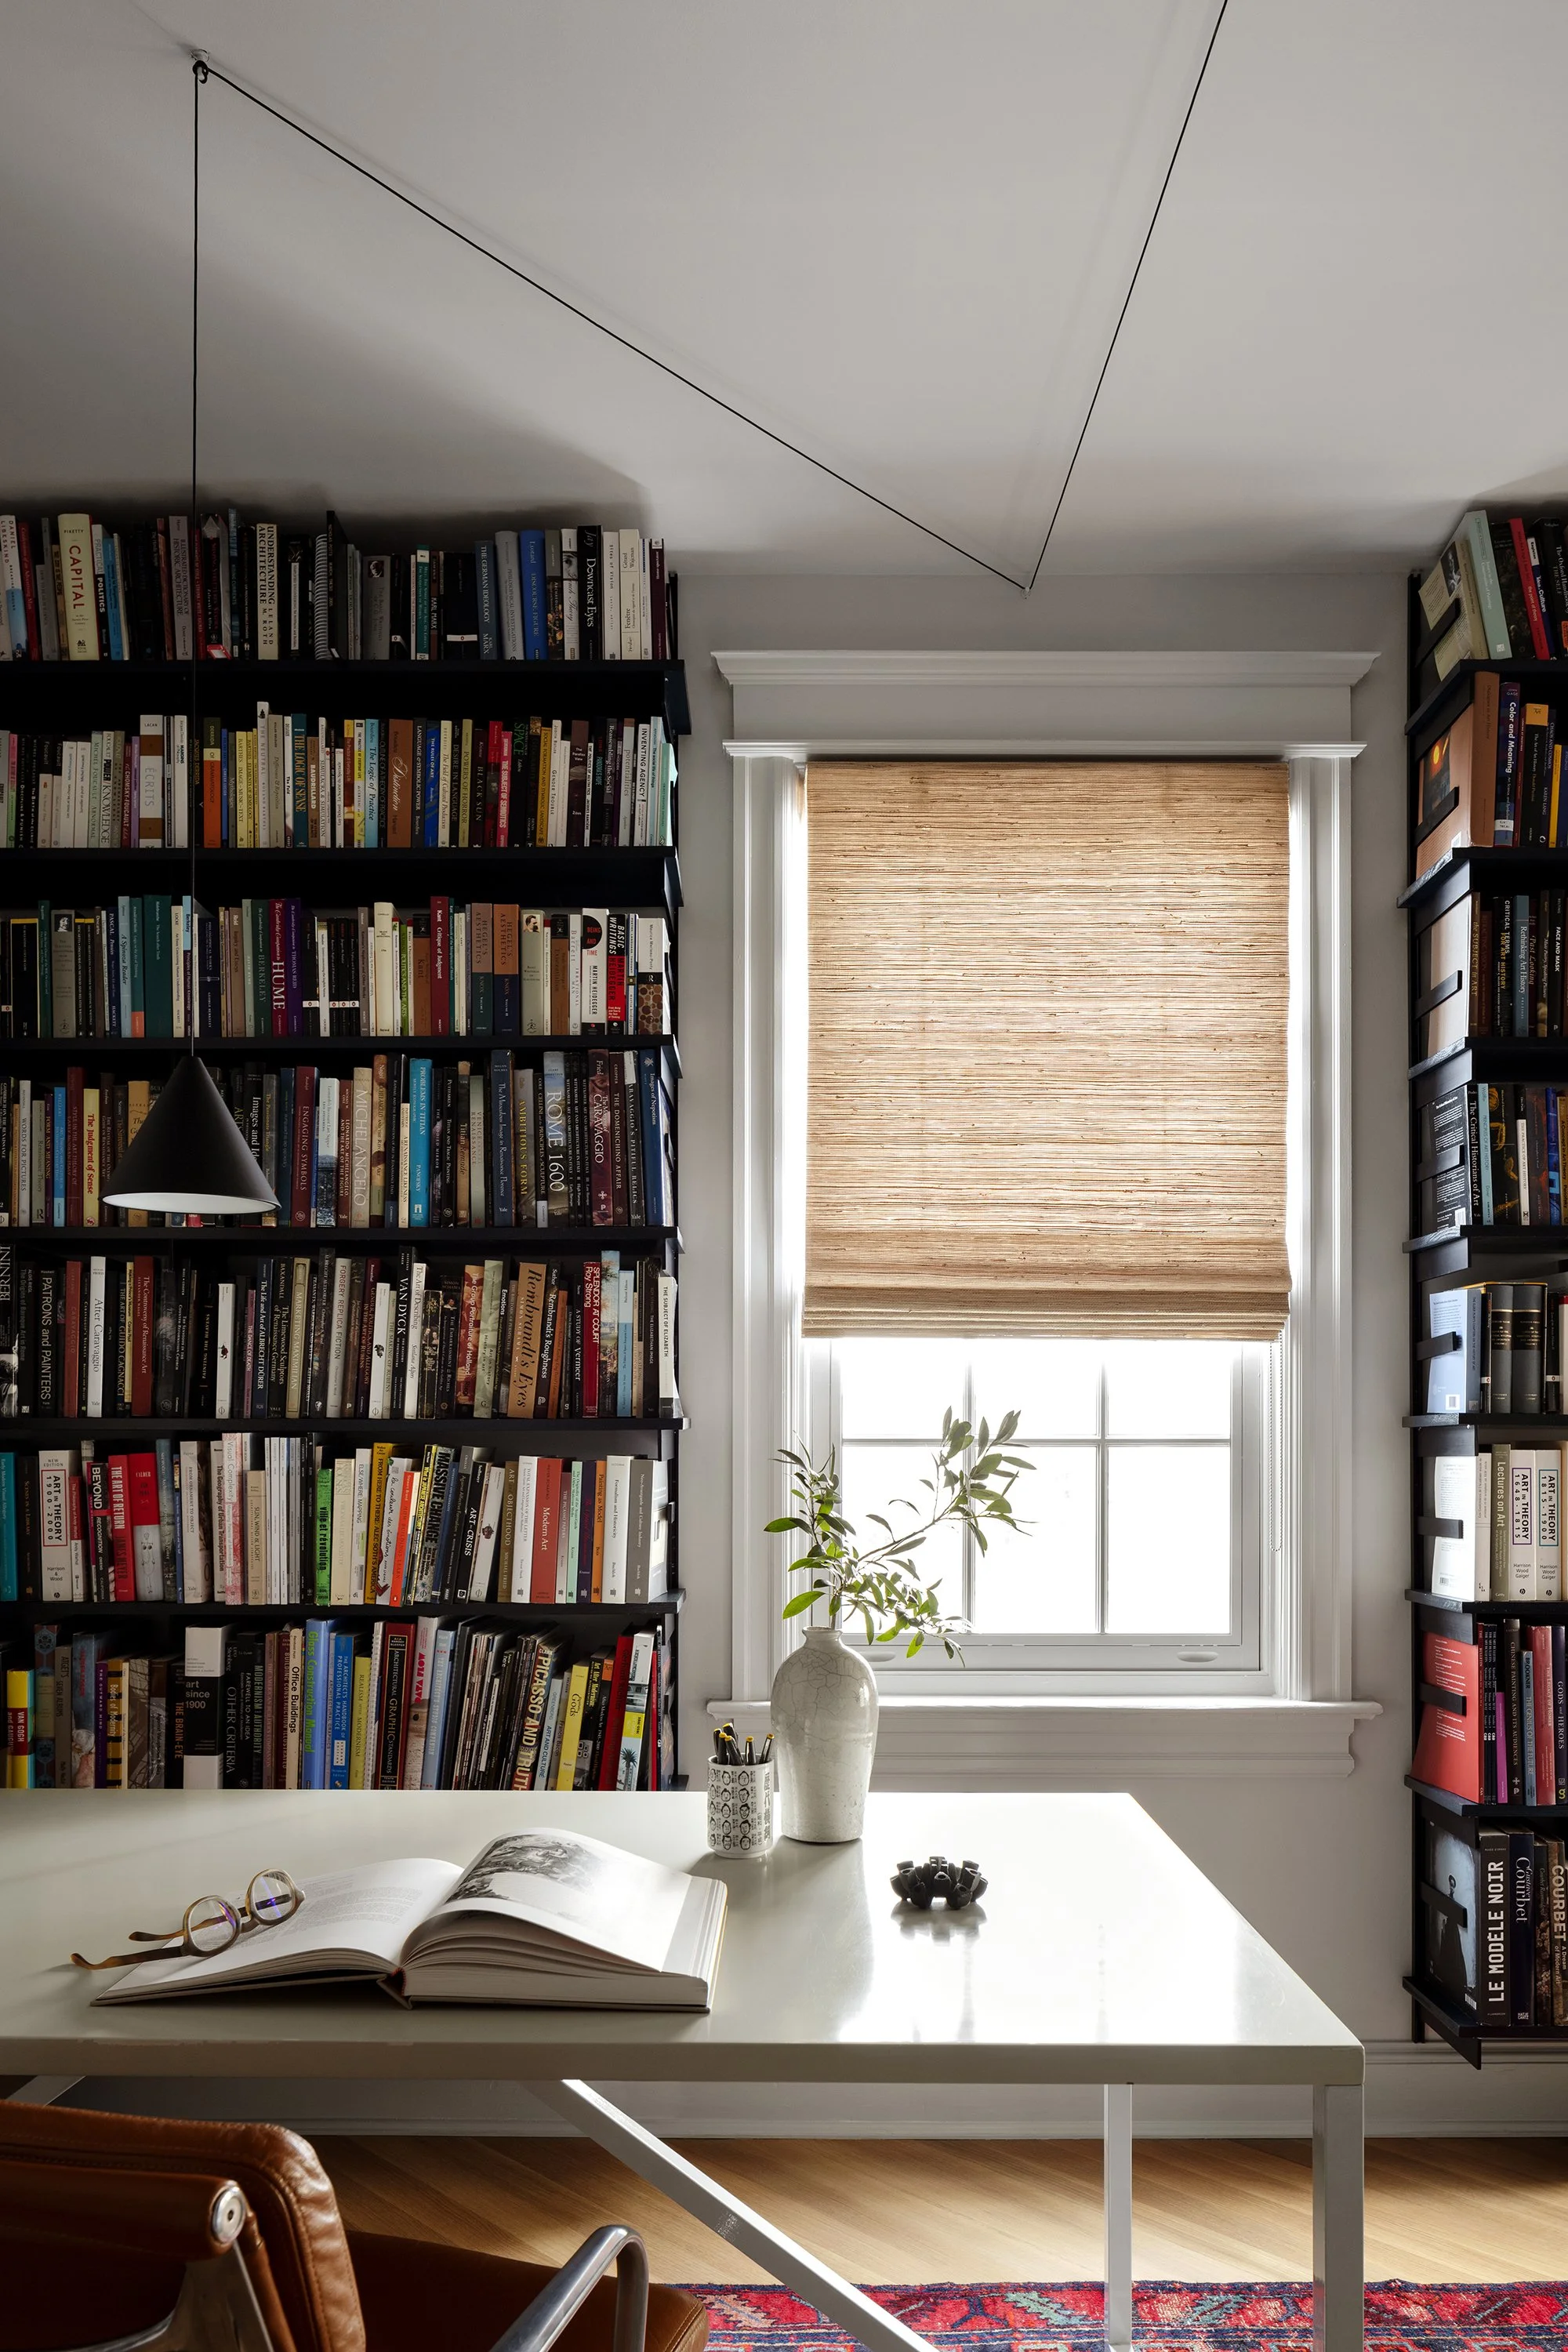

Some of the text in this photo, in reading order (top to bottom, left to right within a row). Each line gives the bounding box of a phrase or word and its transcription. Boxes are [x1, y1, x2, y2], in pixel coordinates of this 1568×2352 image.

[0, 521, 9, 563] LIBESKIND
[584, 531, 596, 546] Jay
[69, 546, 84, 609] CAPITAL
[585, 558, 597, 626] Downcast Eyes
[514, 723, 524, 755] SPACE
[1505, 741, 1514, 773] Meaning
[100, 758, 111, 844] POWER/KNOWLEDGE
[145, 768, 157, 806] ÉCRITS
[368, 782, 376, 791] of
[393, 757, 408, 811] Distinction
[463, 782, 468, 790] OF
[1519, 927, 1527, 959] Rethinking
[273, 962, 285, 1009] HUME
[1519, 972, 1527, 993] History
[594, 1061, 604, 1076] Fried
[85, 1130, 95, 1163] Judgment
[354, 1090, 368, 1205] MICHELANGELO
[546, 1091, 566, 1191] ROME 1600
[592, 1094, 604, 1163] CARAVAGGIO
[1473, 1184, 1480, 1192] of
[584, 1267, 593, 1307] Roy Strong
[397, 1305, 407, 1334] DYCK
[593, 1308, 599, 1317] AT
[41, 1278, 52, 1399] PATRONS and PAINTERS
[92, 1325, 102, 1372] Caravaggio
[514, 1269, 542, 1407] Rembrandt's Eyes
[541, 1293, 556, 1378] Rembrandt's Roughness
[93, 1468, 102, 1508] BEYOND
[111, 1467, 122, 1479] THE
[112, 1481, 123, 1492] ART
[227, 1464, 235, 1501] Complexity
[114, 1504, 125, 1529] RETURN
[425, 1451, 452, 1544] MASSIVE CHANGE
[1497, 1501, 1504, 1511] on
[318, 1534, 328, 1571] révolution
[303, 1632, 318, 1753] Glass Construction Manual
[522, 1655, 552, 1745] PICASSO AND
[570, 1693, 581, 1716] Gods
[227, 1687, 236, 1773] OTHER CRITERIA
[289, 1695, 299, 1733] Buildings
[1516, 1857, 1532, 1922] Courbet
[1552, 1864, 1566, 1941] COURBET
[1487, 1861, 1504, 2001] LE MODÈLE NOIR
